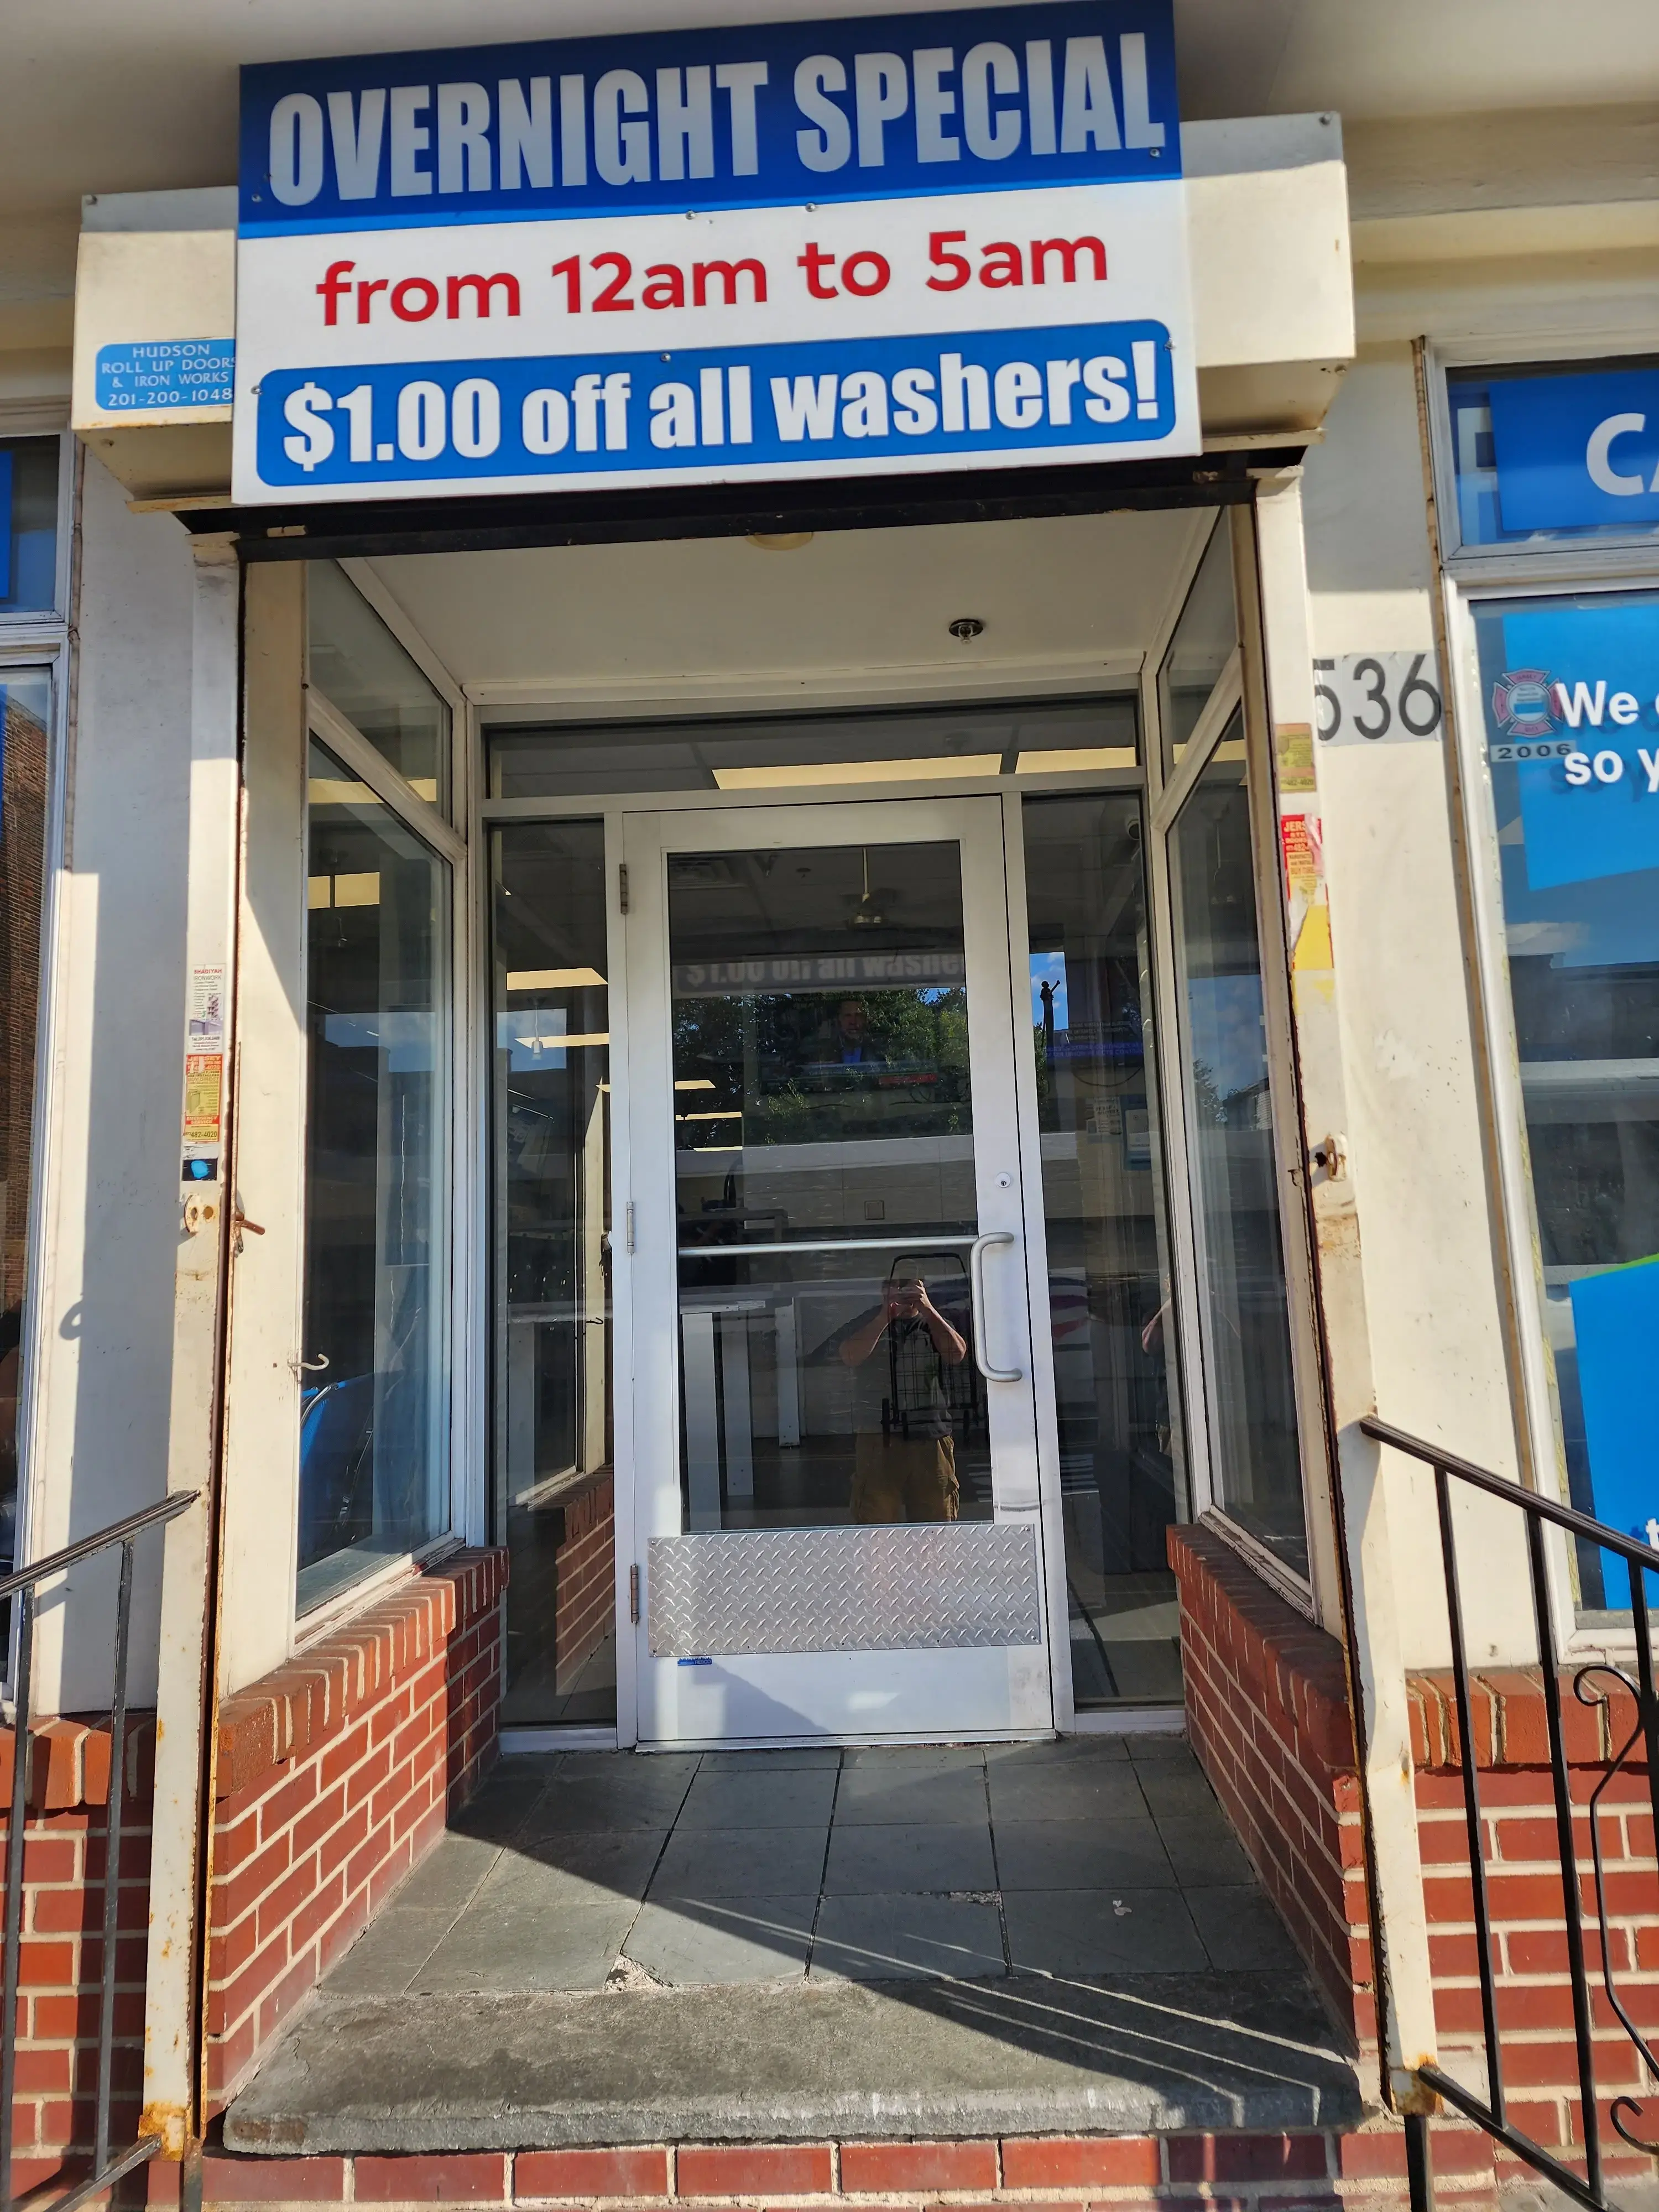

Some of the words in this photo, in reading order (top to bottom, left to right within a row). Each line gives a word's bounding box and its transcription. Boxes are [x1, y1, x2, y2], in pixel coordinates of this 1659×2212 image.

[268, 60, 769, 206] OVERNIGHT
[792, 32, 1166, 173] SPECIAL
[316, 260, 521, 326] from
[552, 252, 768, 314] 12am
[797, 242, 891, 299] to
[926, 230, 1108, 292] 5am
[102, 361, 144, 374] ROLL
[152, 360, 175, 372] UP
[182, 357, 236, 371] DOORS
[133, 344, 210, 358] HUDSON
[108, 388, 233, 406] 201-200-1048
[112, 377, 123, 388] &
[134, 375, 170, 387] IRON
[178, 371, 229, 384] WORKS
[283, 378, 502, 472] $1.00
[521, 372, 632, 455] off
[649, 365, 753, 448] all
[769, 340, 1159, 441] washers!
[1586, 412, 1659, 496] C
[1312, 653, 1442, 742] 536
[1556, 680, 1640, 728] We
[1498, 743, 1572, 759] 2006
[1564, 750, 1624, 785] so
